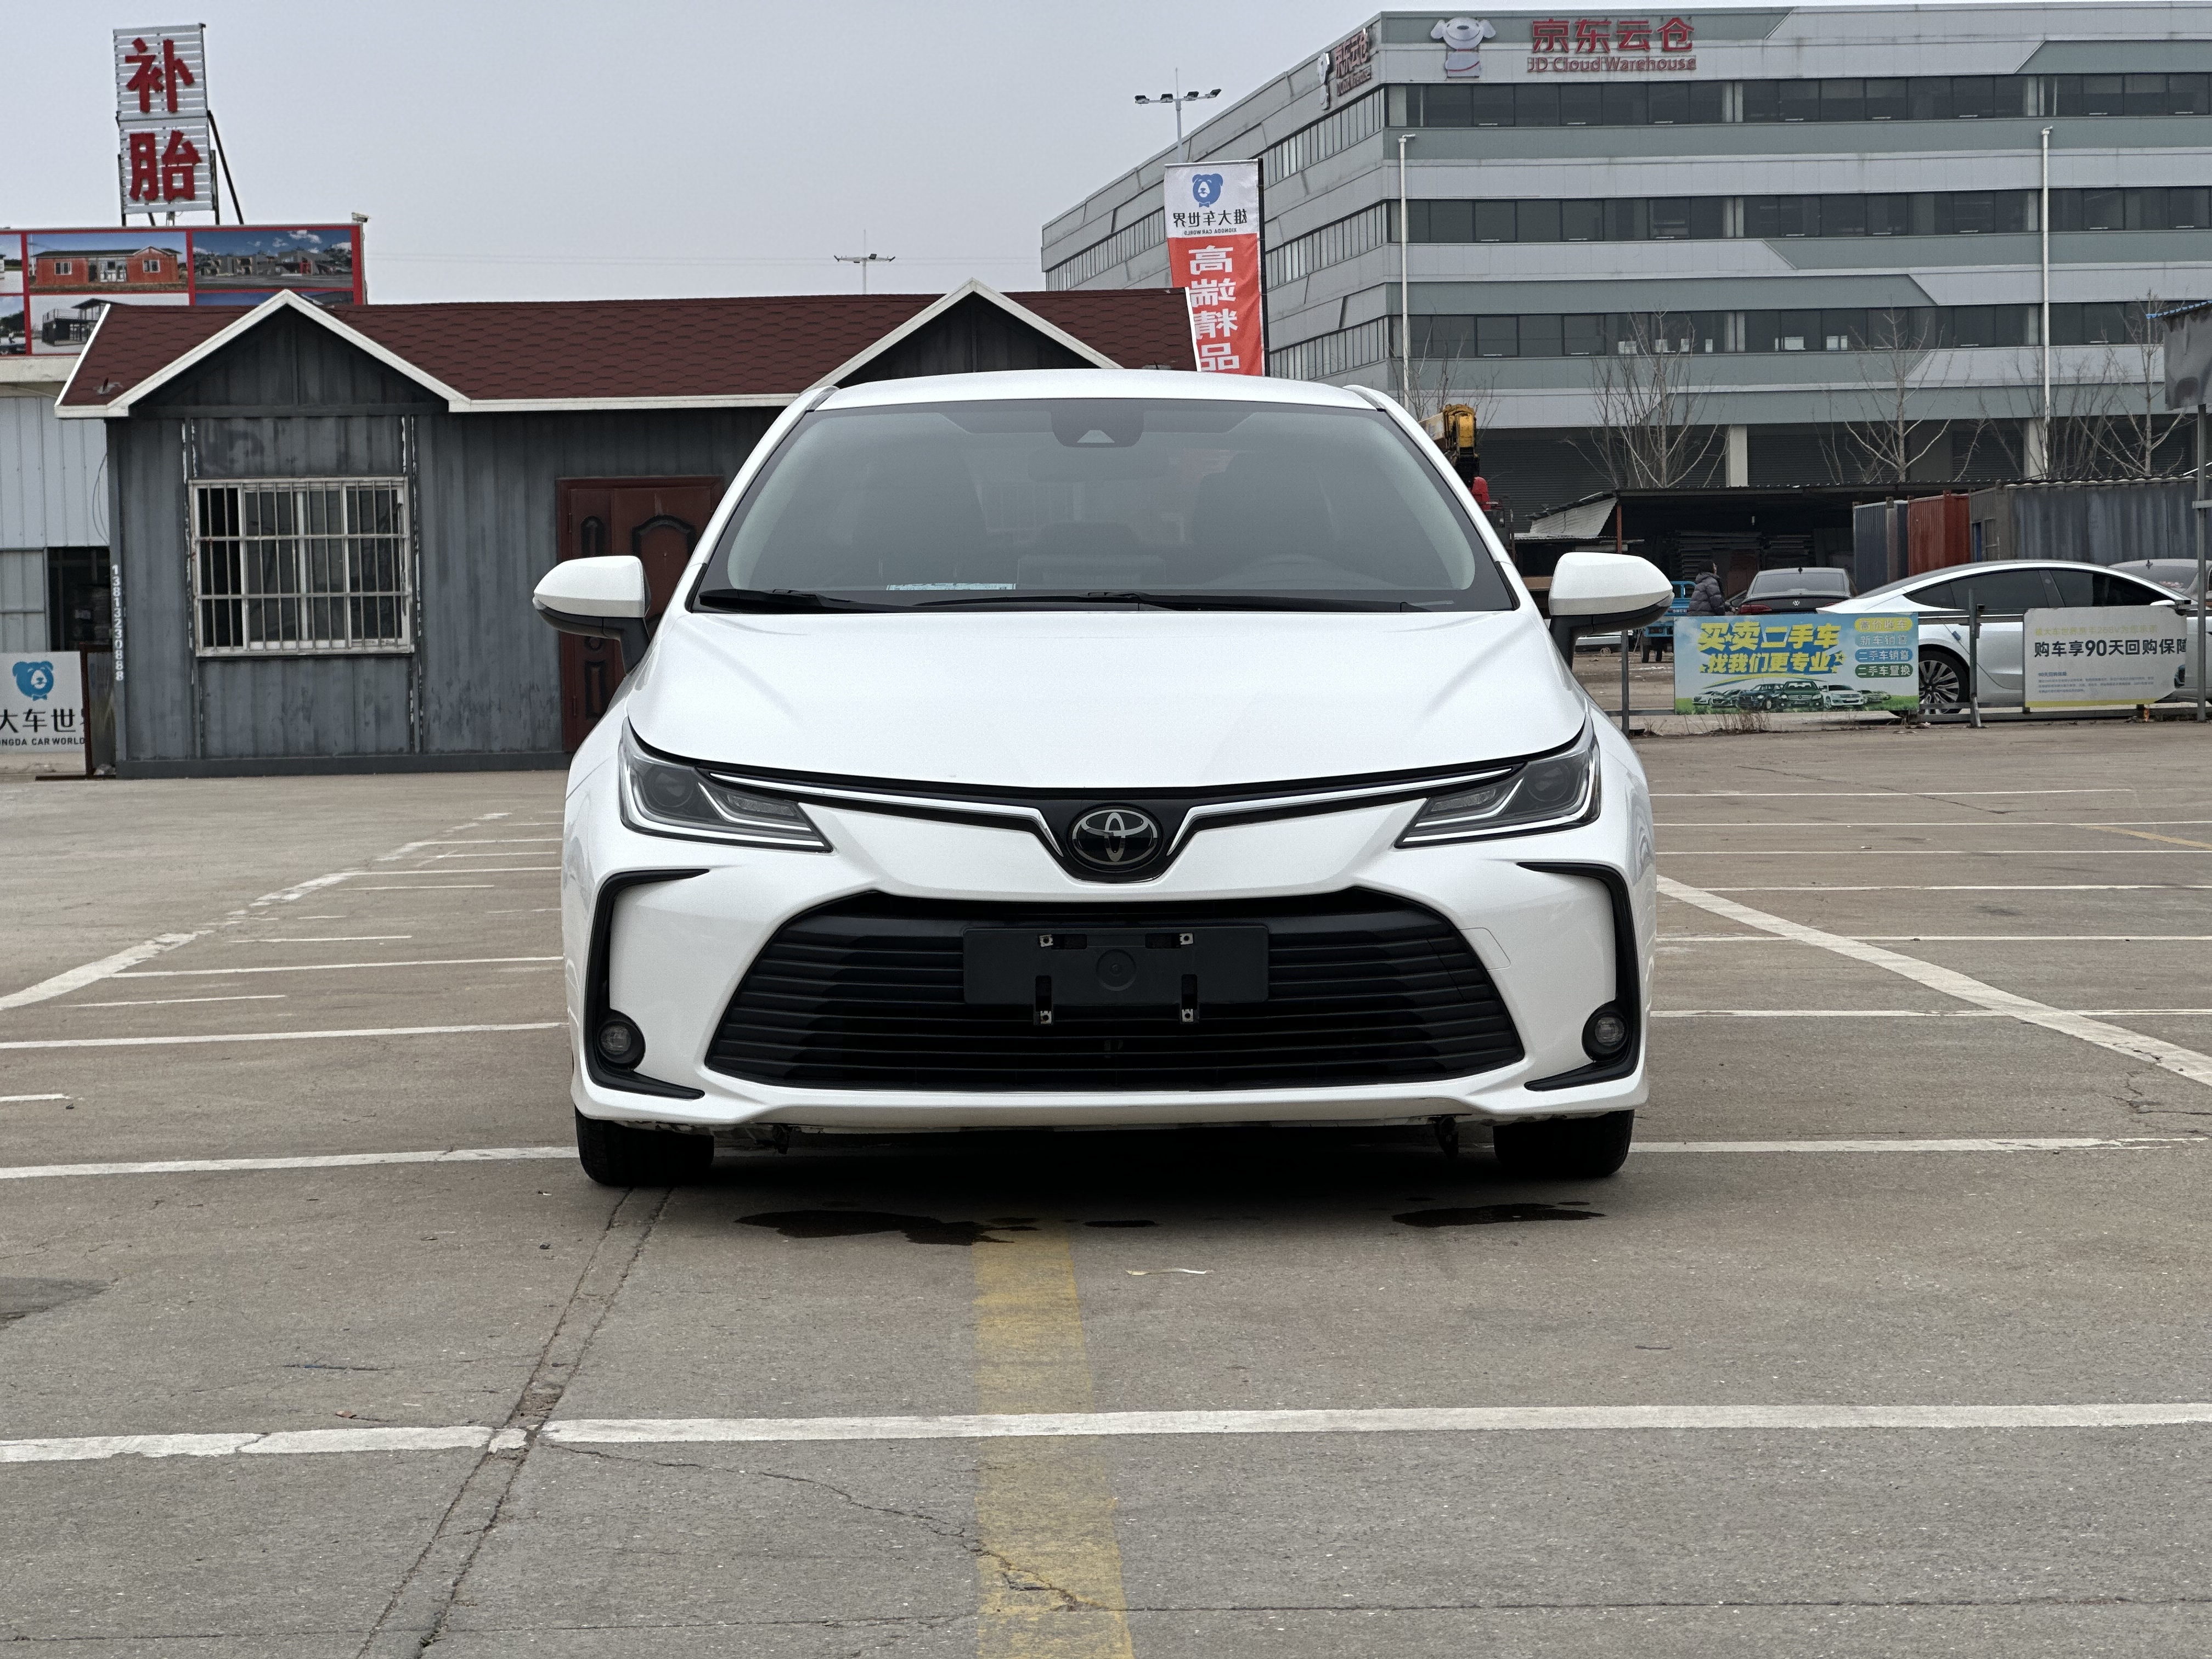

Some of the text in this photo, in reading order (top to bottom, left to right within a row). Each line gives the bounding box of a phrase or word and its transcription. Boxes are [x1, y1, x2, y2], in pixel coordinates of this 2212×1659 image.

[1532, 17, 1696, 53] 京东云仓
[1528, 55, 1697, 72] JD Cloud Warehouse
[125, 37, 202, 203] 补胎
[112, 565, 124, 681] 13813230888
[1860, 620, 1907, 630] 高价收车
[1697, 621, 1842, 651] 买卖二手车
[1860, 635, 1908, 645] 新车销售
[1708, 652, 1835, 673] 找我们更专业
[1859, 650, 1909, 661] 二手车销售
[1858, 665, 1910, 676] 二手车置换
[0, 708, 84, 733] 大车世
[0, 738, 27, 746] NGDA
[31, 737, 50, 746] CAR
